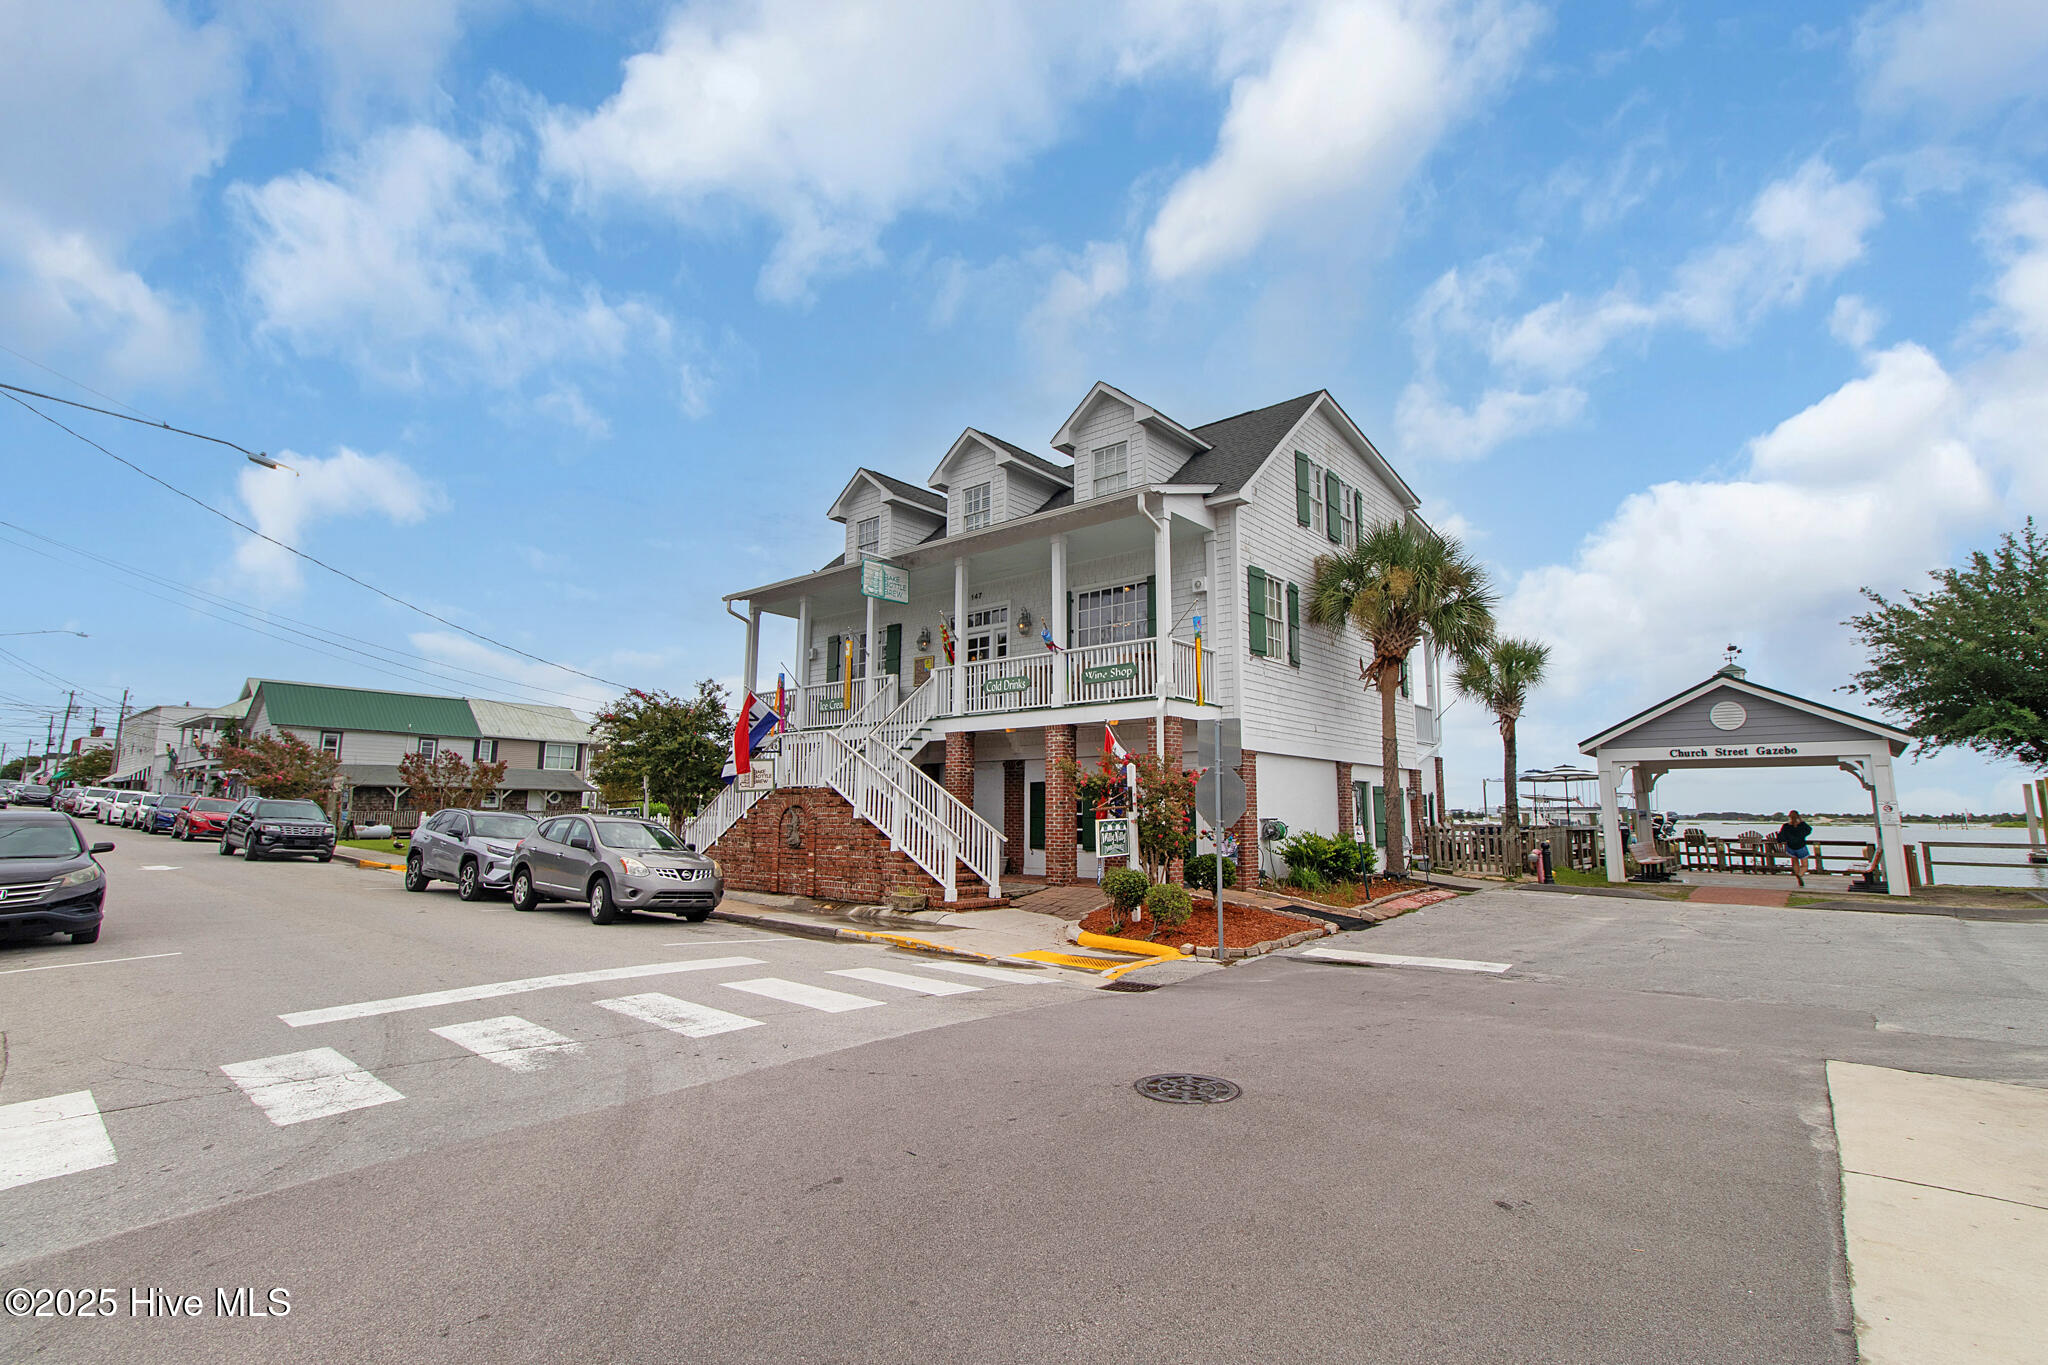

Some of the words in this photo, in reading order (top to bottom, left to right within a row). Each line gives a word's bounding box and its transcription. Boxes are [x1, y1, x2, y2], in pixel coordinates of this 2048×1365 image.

[971, 592, 982, 600] 147
[1085, 670, 1108, 680] Wine
[1110, 667, 1133, 678] Shop
[986, 681, 1002, 692] Cold
[1003, 679, 1026, 691] Drinks
[820, 701, 829, 711] Ice
[830, 700, 844, 710] Crea
[1669, 748, 1708, 758] Church
[1715, 747, 1749, 757] Street
[1755, 745, 1798, 756] Gazebo
